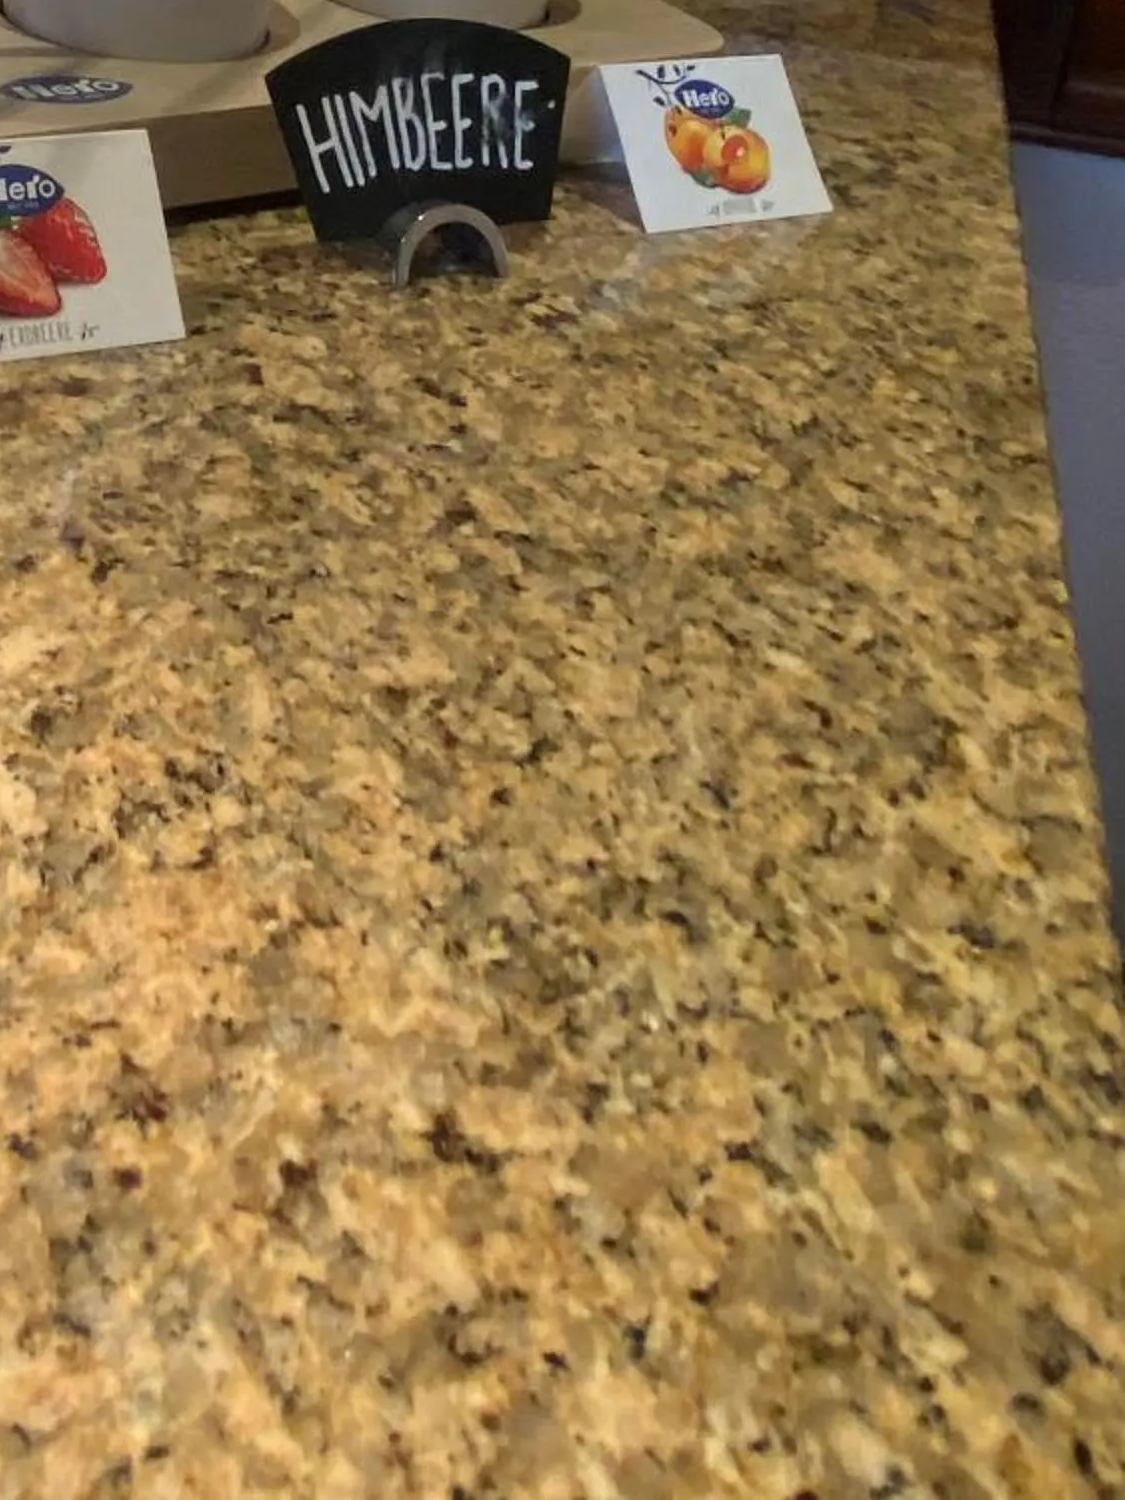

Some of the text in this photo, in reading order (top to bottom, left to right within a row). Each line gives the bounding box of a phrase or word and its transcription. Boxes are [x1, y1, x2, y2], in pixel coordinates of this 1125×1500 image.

[12, 78, 119, 100] Hero
[682, 88, 730, 107] Hero
[296, 73, 539, 193] HIMBEERE
